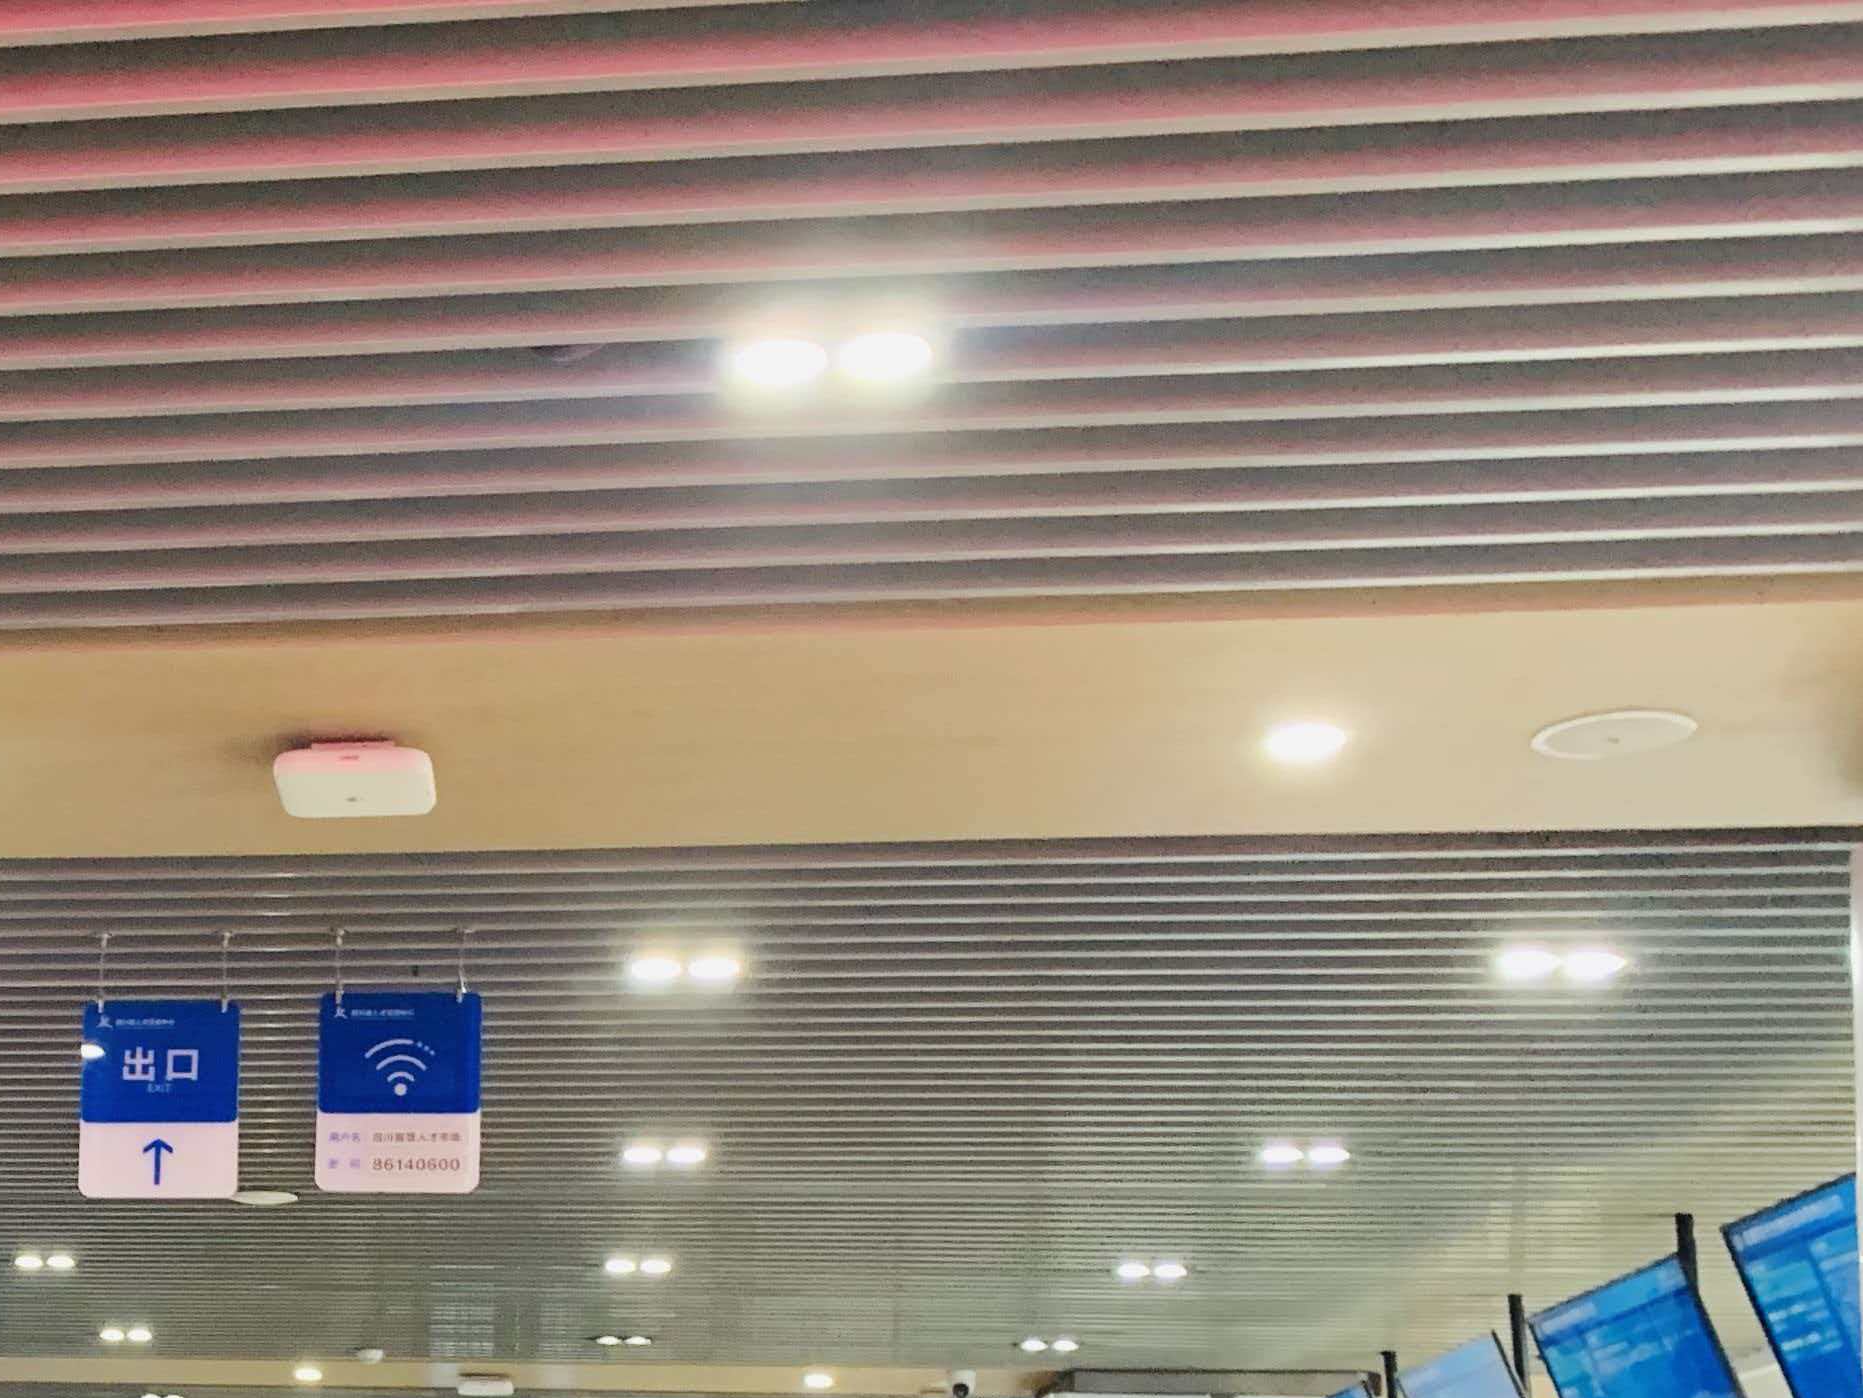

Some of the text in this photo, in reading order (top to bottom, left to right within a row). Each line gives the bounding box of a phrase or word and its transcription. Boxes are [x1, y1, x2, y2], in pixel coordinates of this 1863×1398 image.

[122, 1046, 199, 1081] 出口
[147, 1083, 173, 1093] EXIT
[372, 1157, 461, 1171] 86140600
